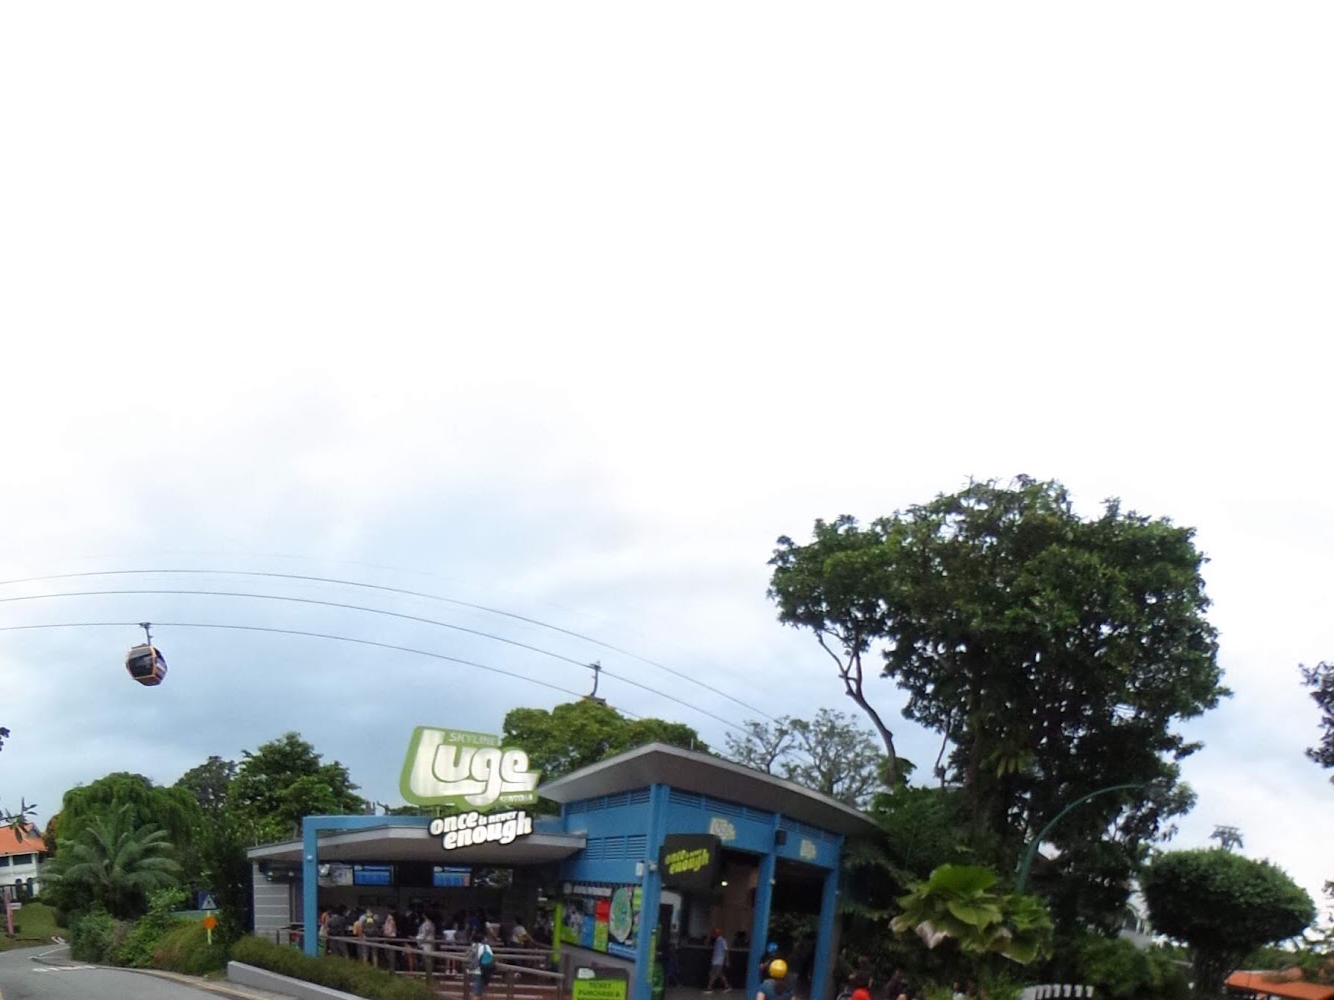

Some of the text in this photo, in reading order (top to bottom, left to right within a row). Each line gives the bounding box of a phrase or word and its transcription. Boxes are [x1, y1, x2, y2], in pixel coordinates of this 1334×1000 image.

[449, 732, 497, 746] SKYLINE
[410, 729, 539, 806] Luge
[430, 811, 478, 835] once
[487, 811, 517, 824] never
[443, 811, 532, 850] enough
[669, 849, 710, 875] enough
